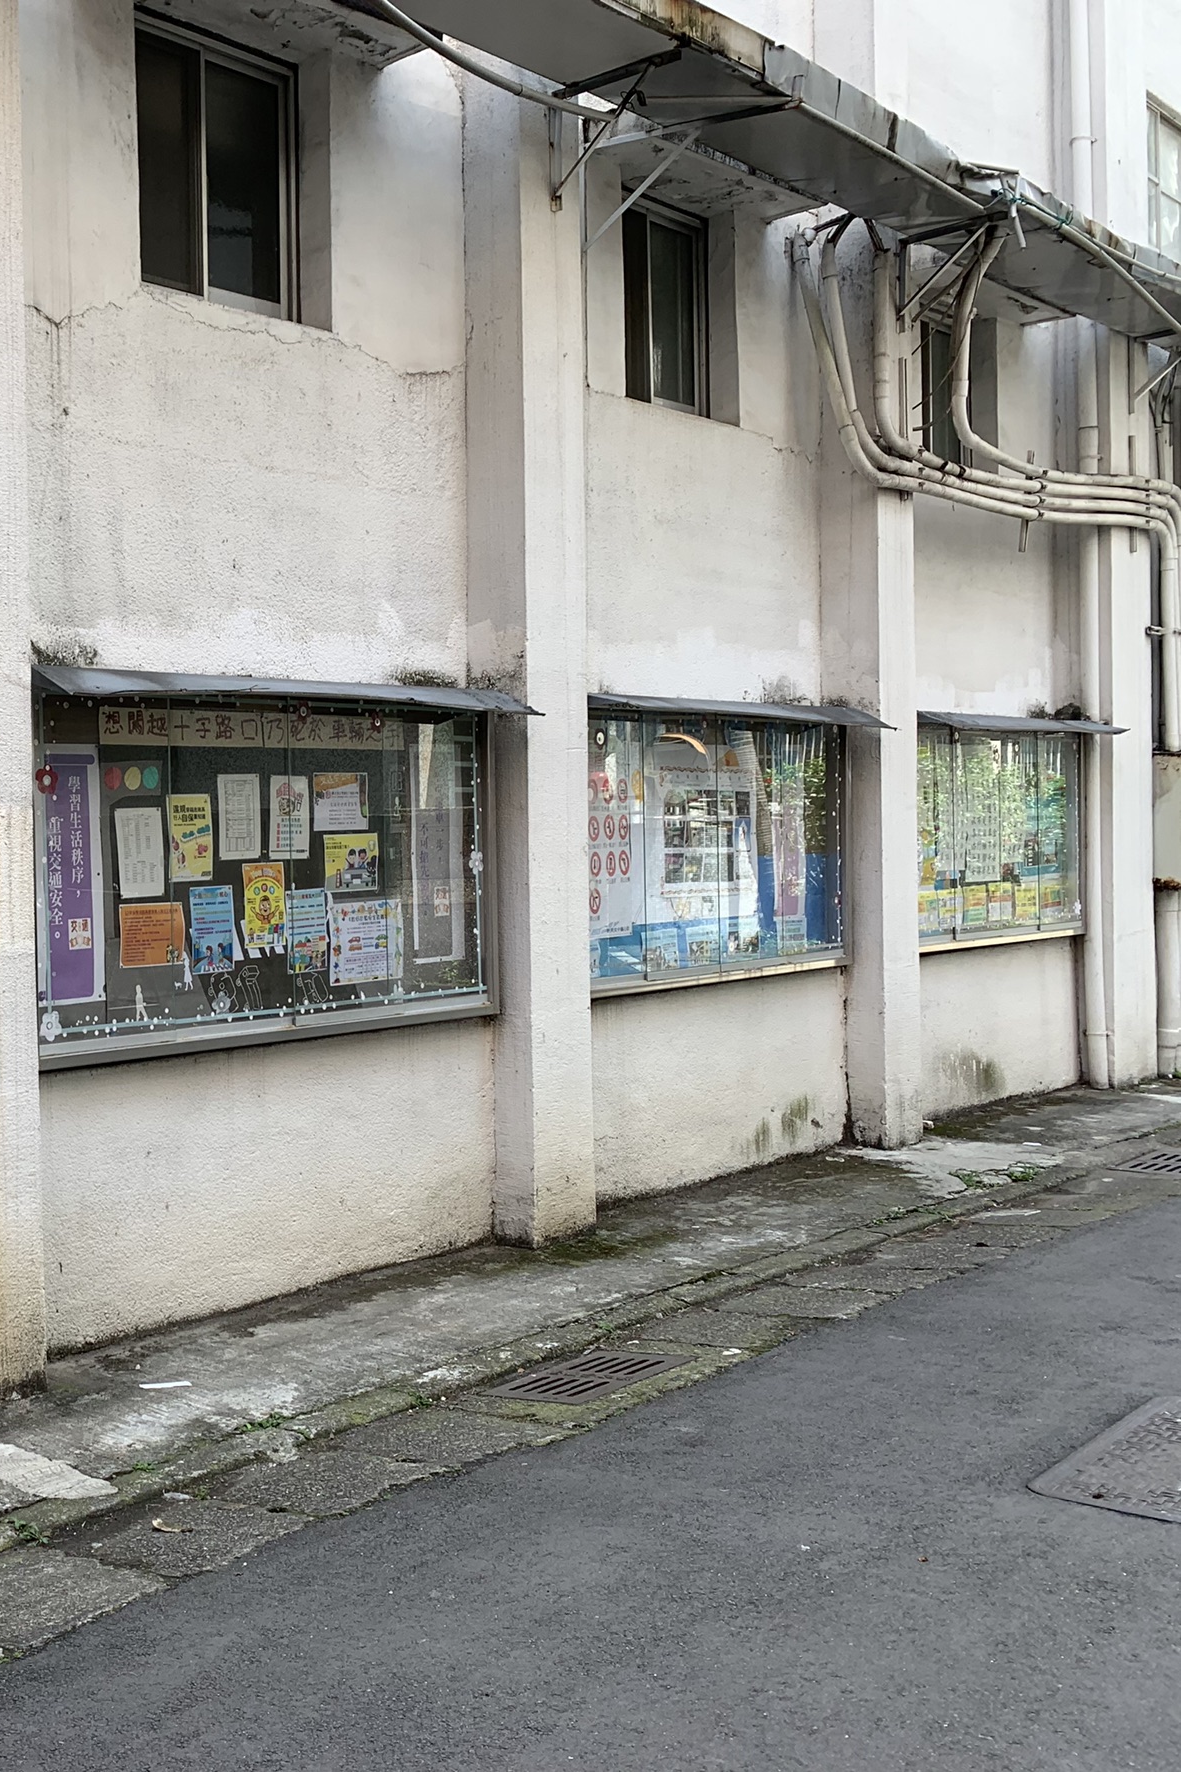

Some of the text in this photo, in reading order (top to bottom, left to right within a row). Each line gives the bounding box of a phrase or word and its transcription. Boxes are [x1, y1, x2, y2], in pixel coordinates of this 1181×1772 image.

[48, 817, 64, 938] 重視交通安全。
[68, 775, 84, 898] 學習生活秩序，
